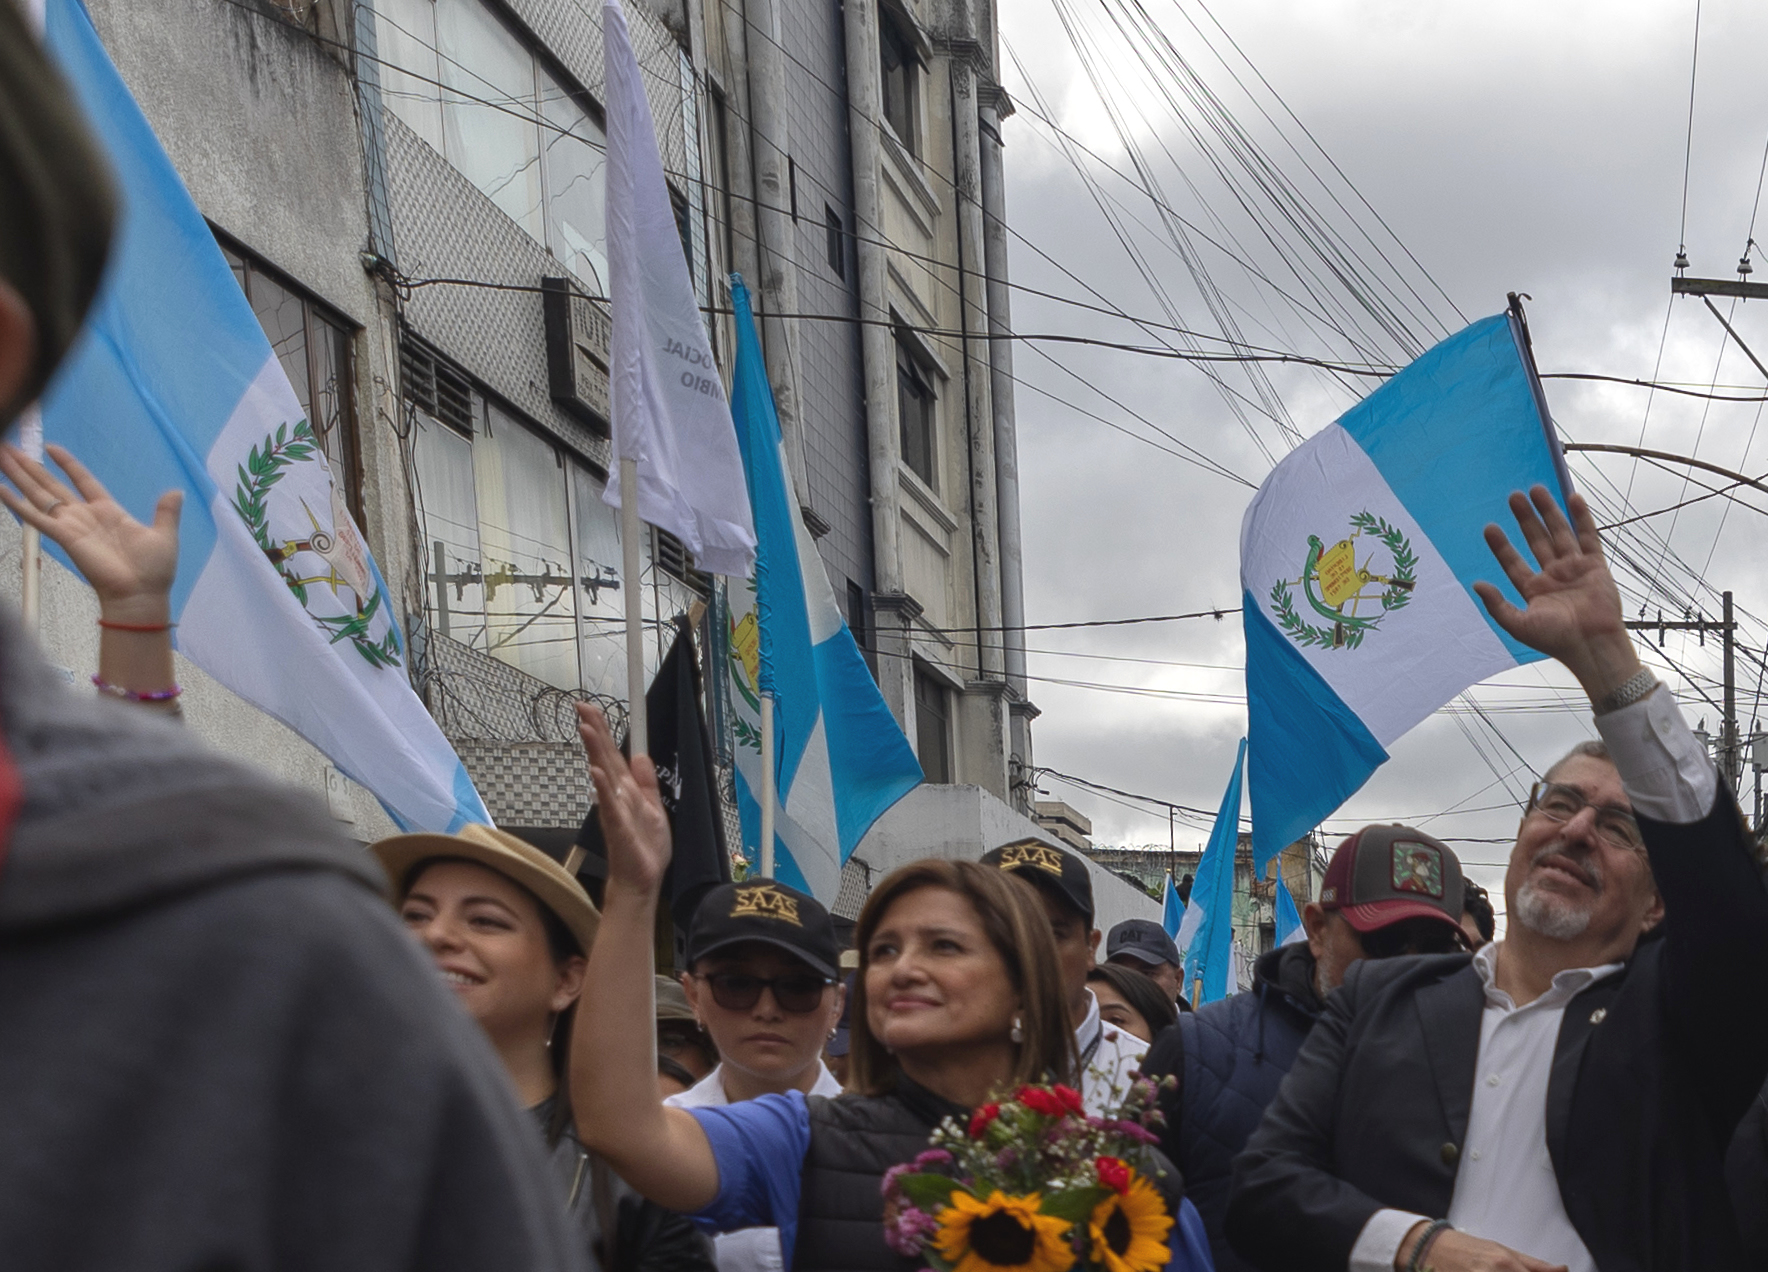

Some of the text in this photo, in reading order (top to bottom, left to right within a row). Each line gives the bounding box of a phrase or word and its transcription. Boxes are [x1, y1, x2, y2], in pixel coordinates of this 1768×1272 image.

[565, 298, 612, 356] HOTE
[1001, 847, 1062, 868] SAAS
[736, 891, 799, 917] SAAS
